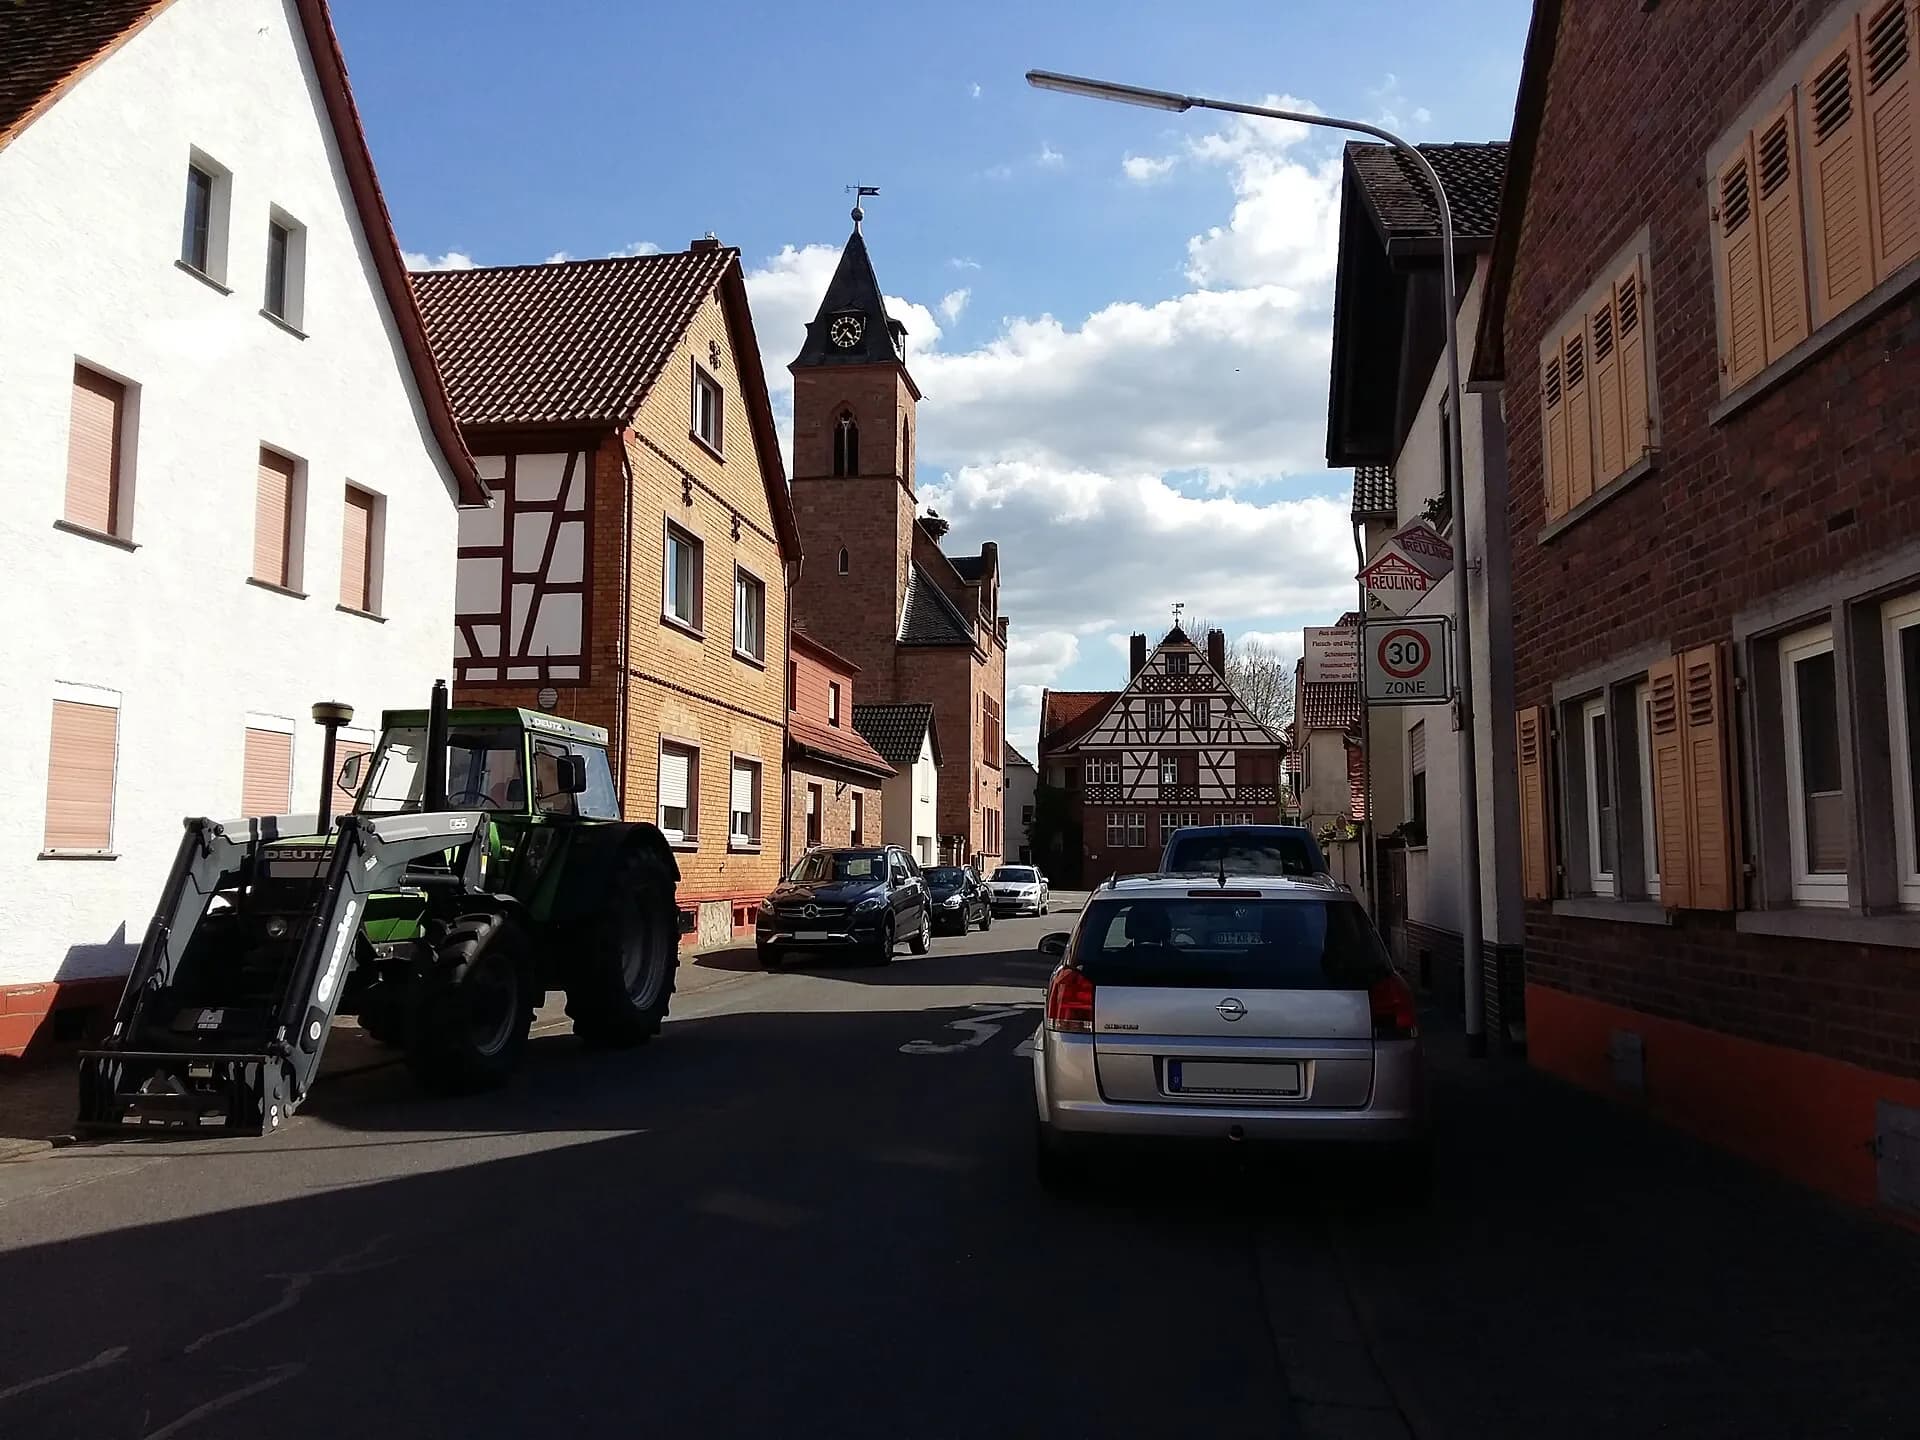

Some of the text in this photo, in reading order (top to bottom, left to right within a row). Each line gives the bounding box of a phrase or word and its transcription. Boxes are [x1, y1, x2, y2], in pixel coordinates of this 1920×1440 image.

[1371, 575, 1422, 590] REULING
[1388, 642, 1420, 665] 30
[1385, 681, 1426, 695] ZONE
[532, 717, 563, 731] DEUTZ
[264, 849, 332, 860] DEUTZ
